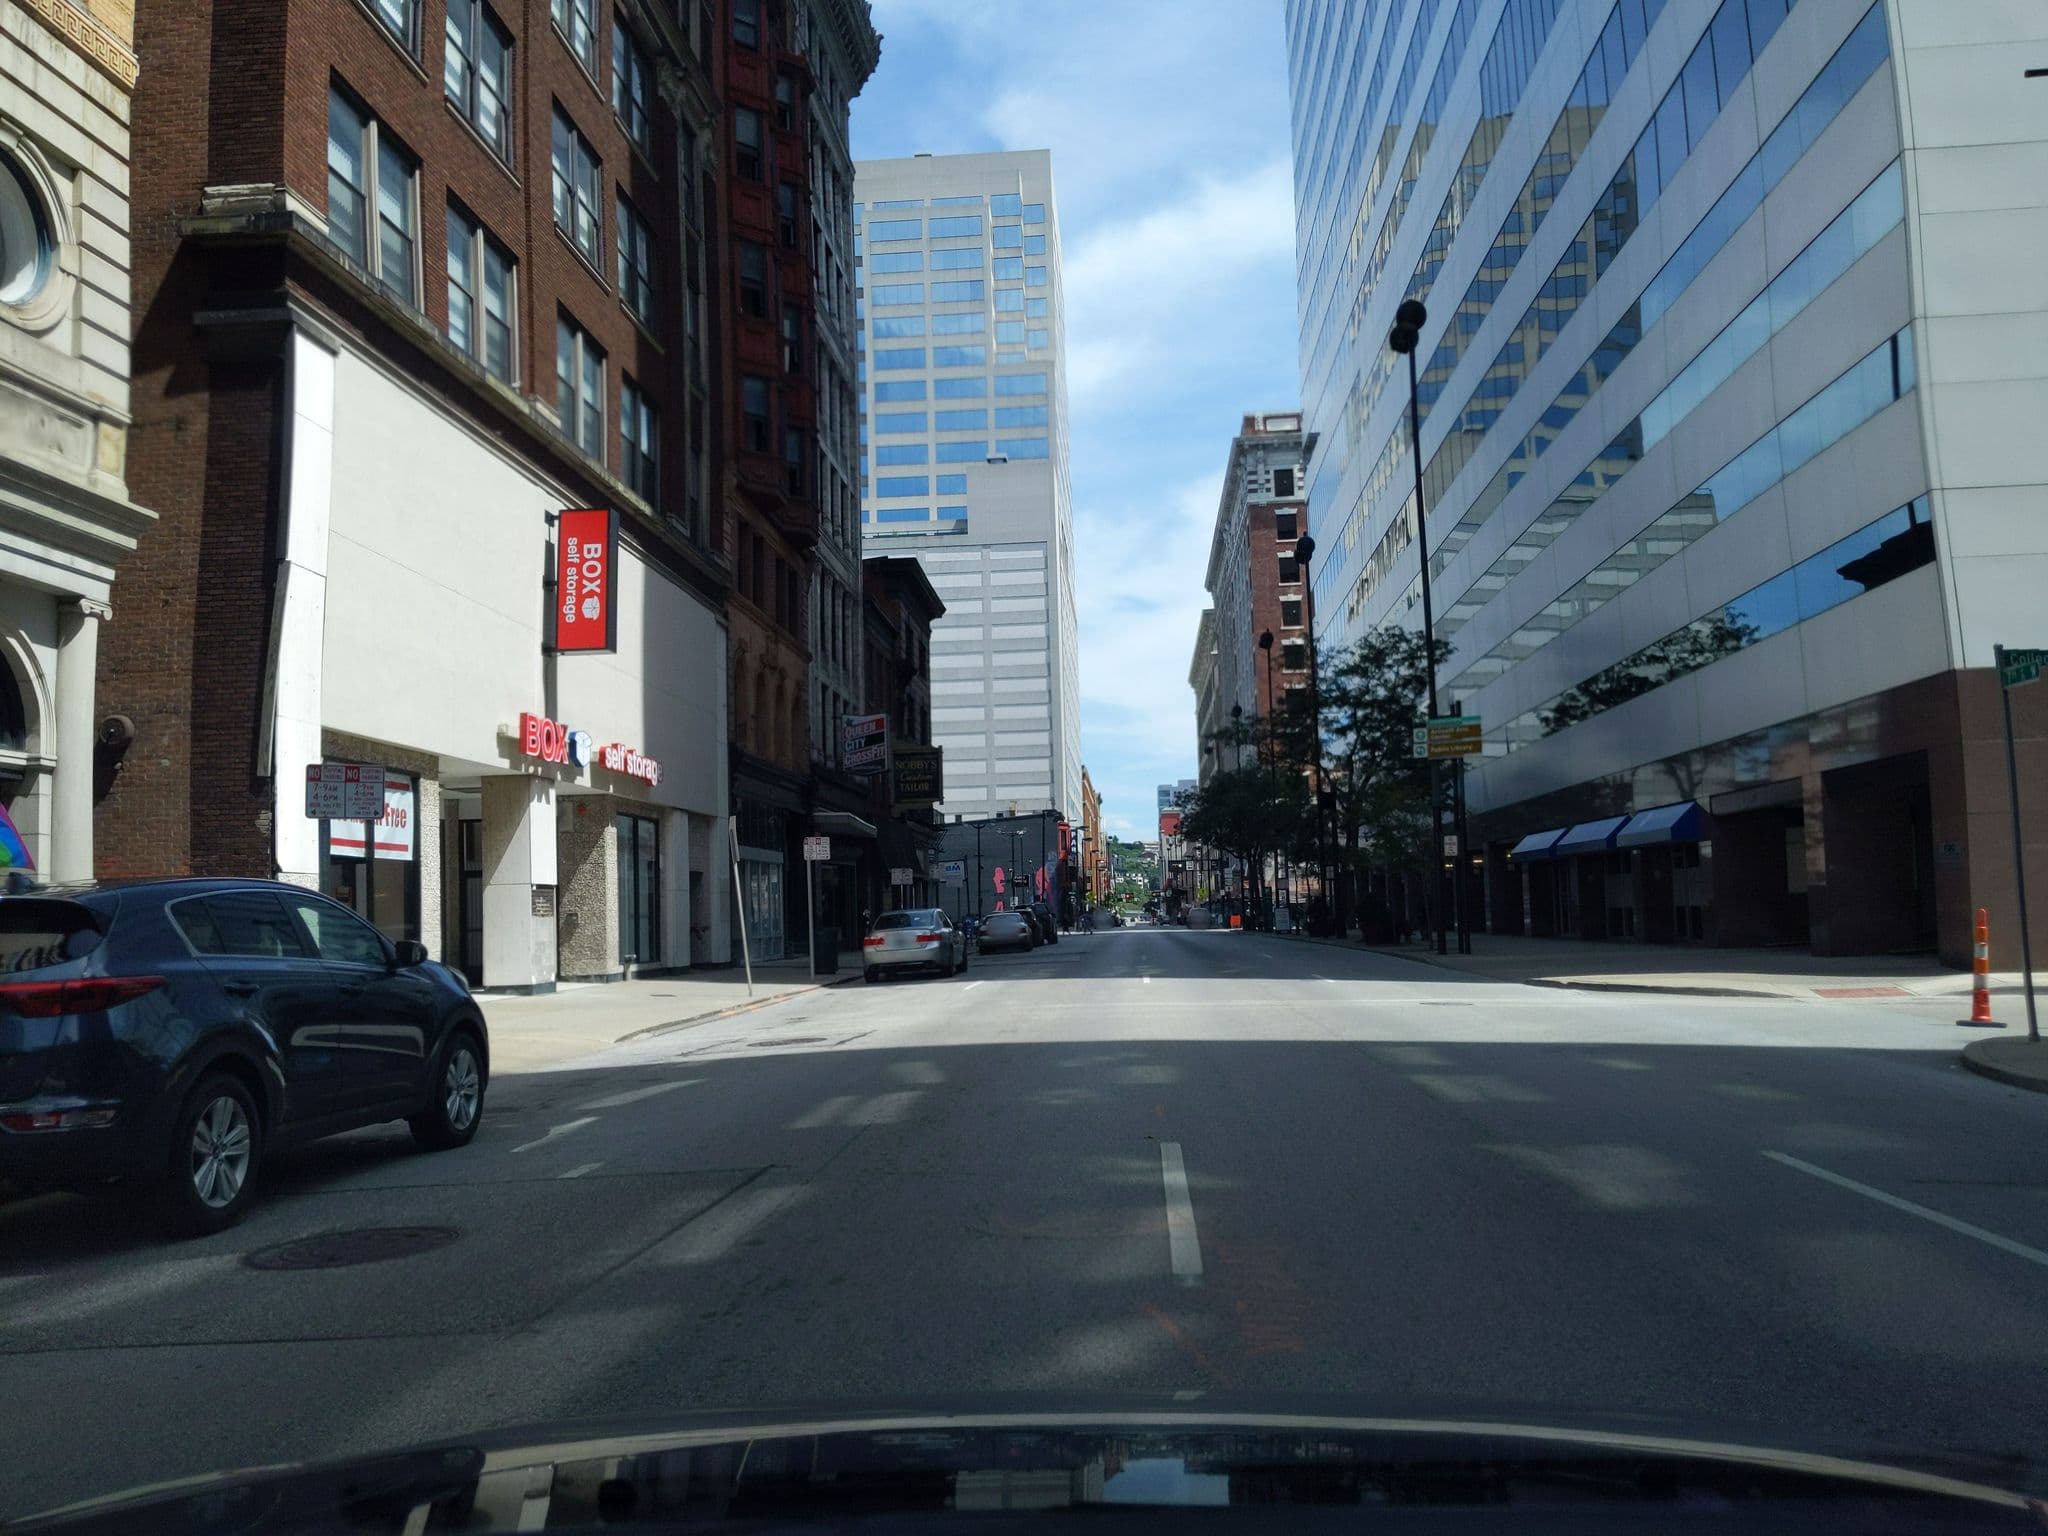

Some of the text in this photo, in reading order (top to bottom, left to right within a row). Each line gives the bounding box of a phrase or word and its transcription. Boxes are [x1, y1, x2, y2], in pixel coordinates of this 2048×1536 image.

[581, 543, 602, 594] BOX
[562, 537, 580, 623] self storage
[844, 722, 876, 738] QUEEN
[520, 712, 569, 765] BOX
[844, 738, 865, 752] CITY
[603, 743, 664, 785] self storage
[307, 767, 321, 779] NO
[346, 768, 359, 780] NO
[901, 782, 930, 794] TAILOR
